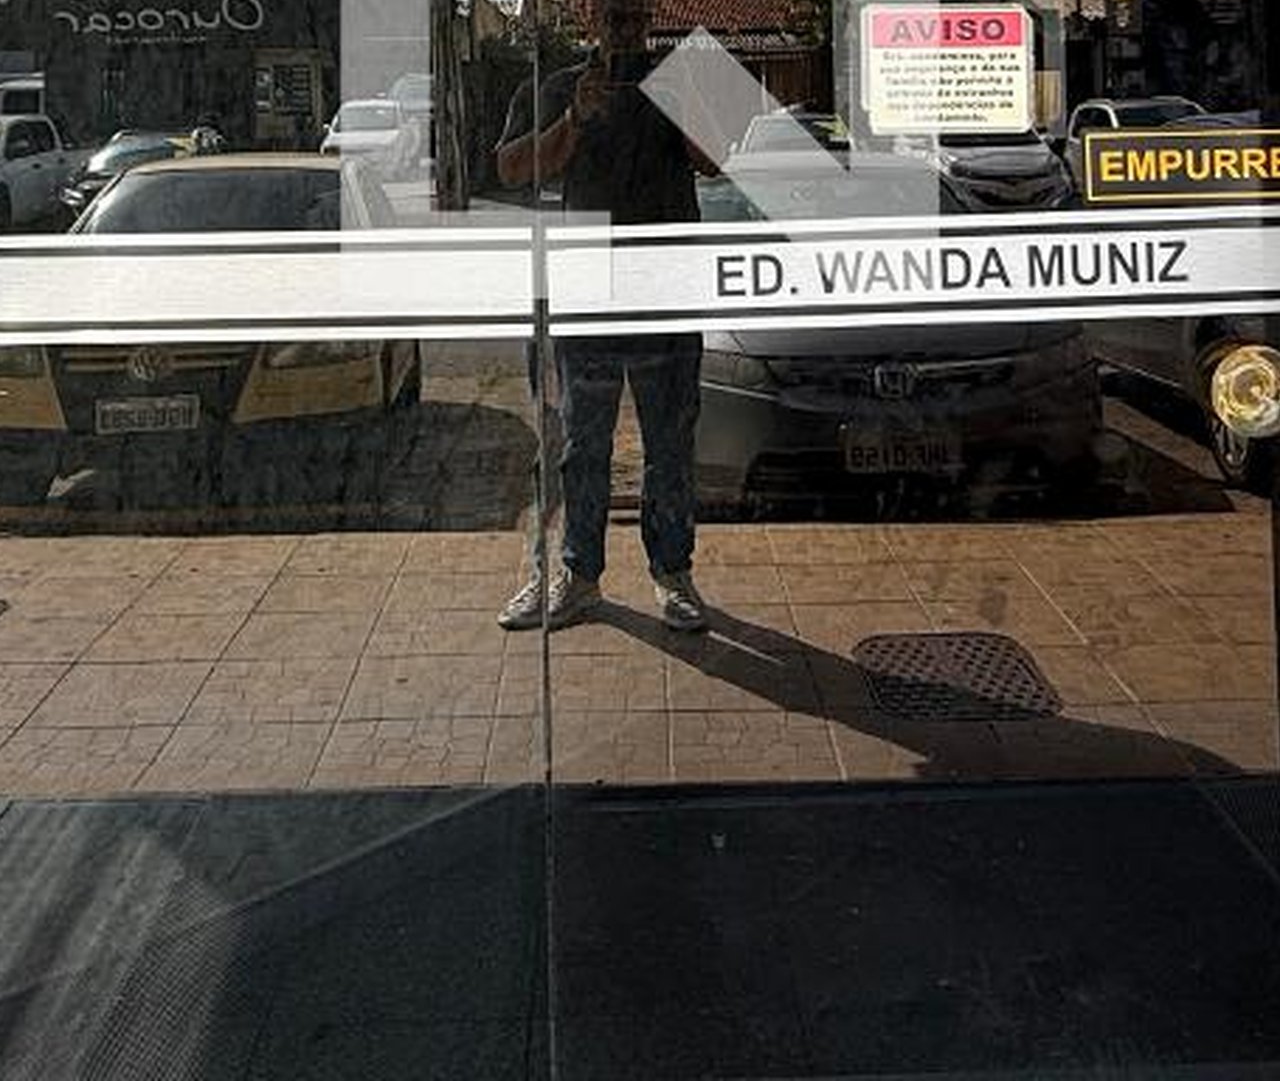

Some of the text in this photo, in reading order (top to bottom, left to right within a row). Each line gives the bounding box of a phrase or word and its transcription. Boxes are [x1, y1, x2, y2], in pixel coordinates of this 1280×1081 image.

[891, 18, 1006, 42] AVISO
[716, 240, 1190, 297] ED. WANDA MUNIZ
